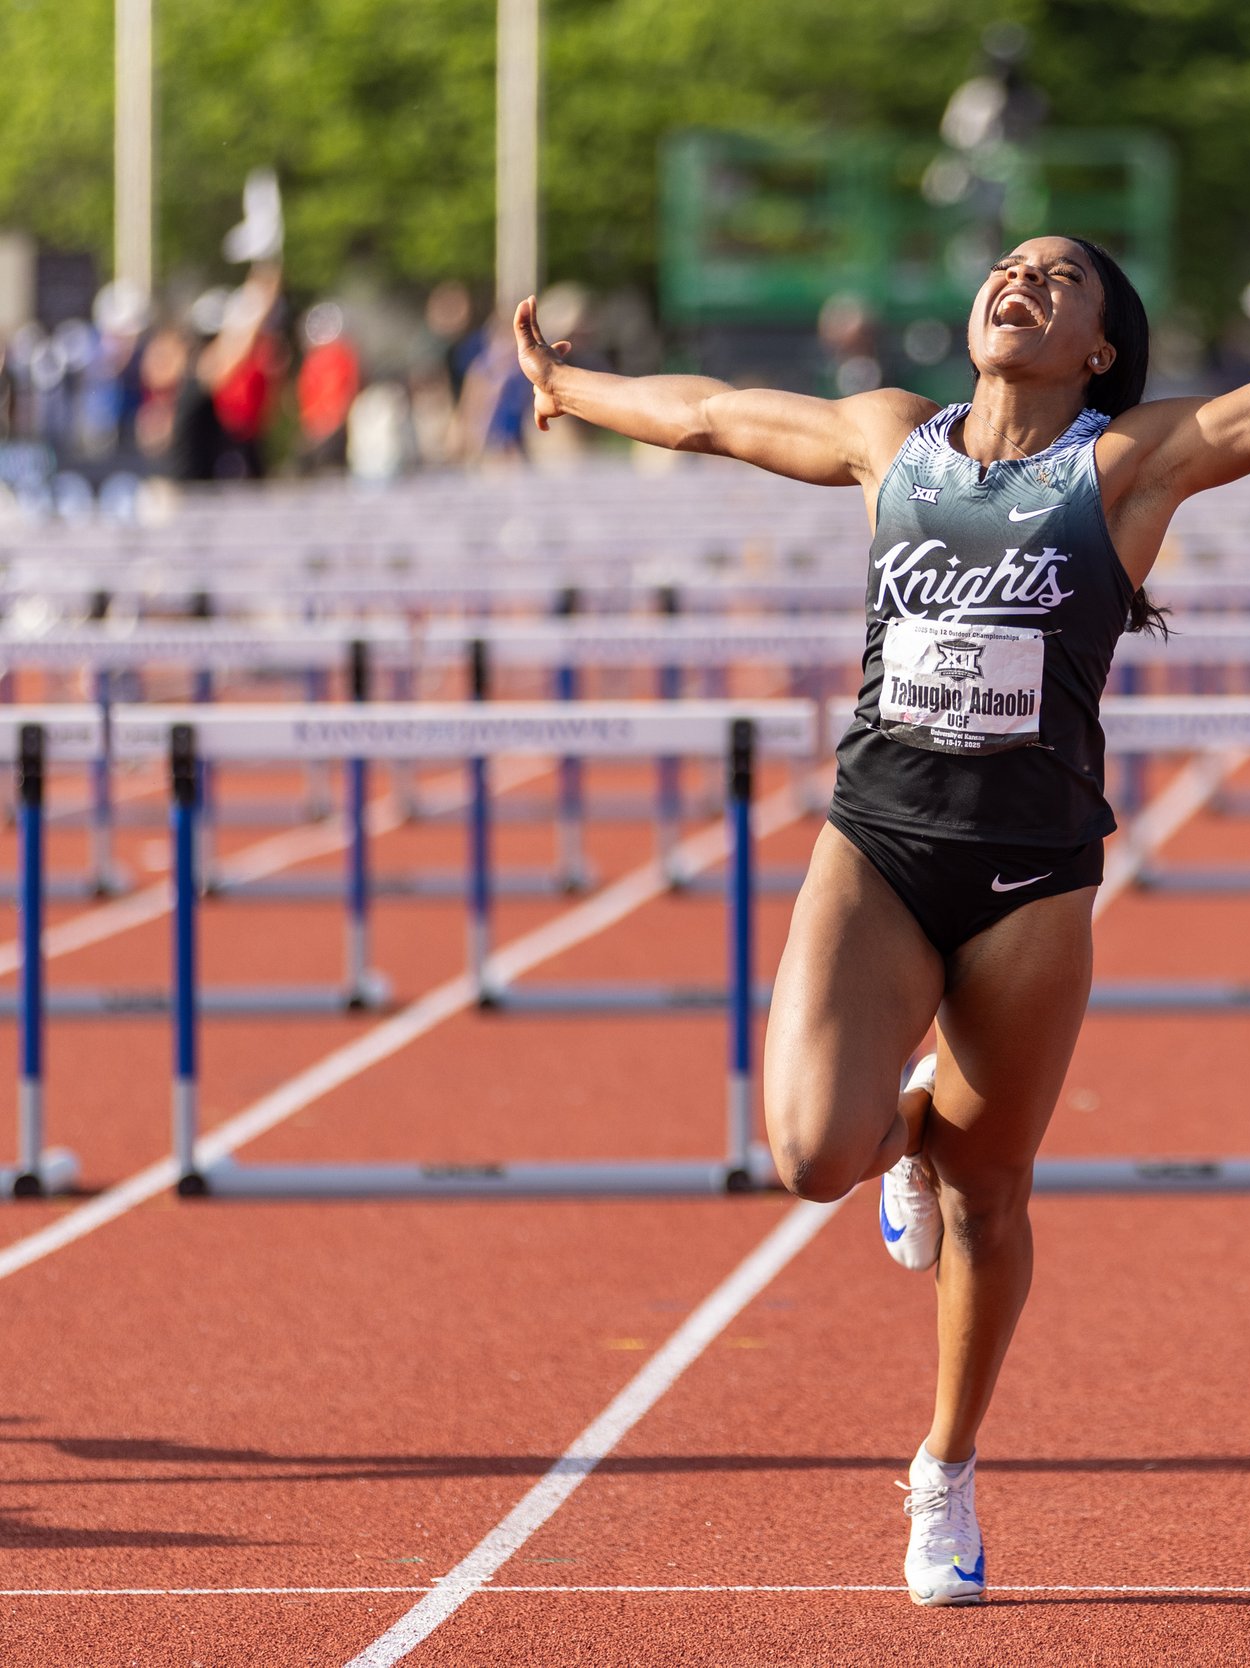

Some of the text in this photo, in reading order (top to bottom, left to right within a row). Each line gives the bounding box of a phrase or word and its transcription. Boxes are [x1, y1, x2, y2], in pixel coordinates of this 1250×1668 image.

[874, 539, 1074, 622] Knights
[949, 630, 971, 638] Outdoor
[972, 632, 1020, 642] Championships
[890, 676, 1036, 717] Tabugbo Adaobi
[947, 713, 970, 729] UCF
[933, 737, 945, 746] May
[964, 741, 981, 749] 2025
